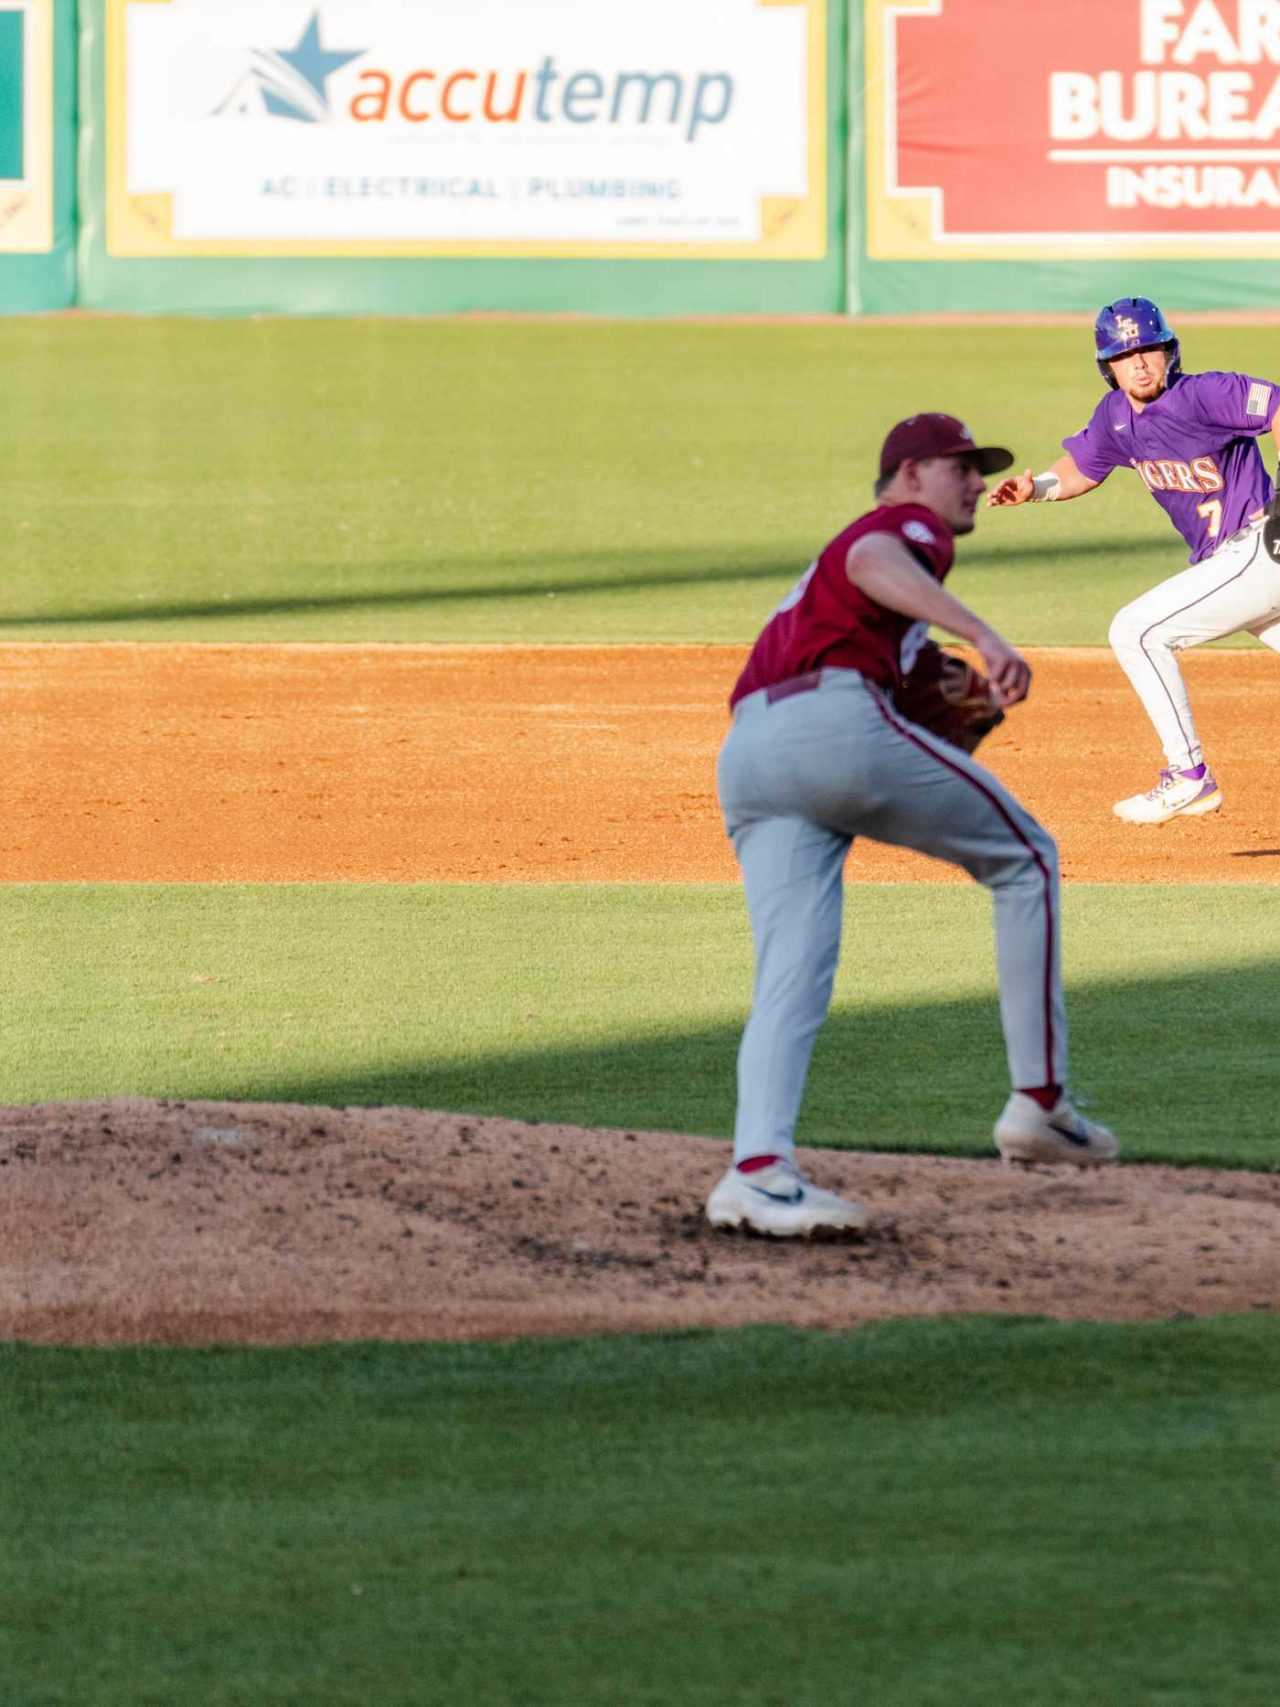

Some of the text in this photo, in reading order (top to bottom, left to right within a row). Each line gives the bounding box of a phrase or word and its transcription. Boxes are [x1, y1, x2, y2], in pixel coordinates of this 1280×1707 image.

[349, 55, 734, 142] accutemp
[261, 176, 682, 200] AC ELECTRICAL PLUMBING
[1197, 499, 1222, 538] 7
